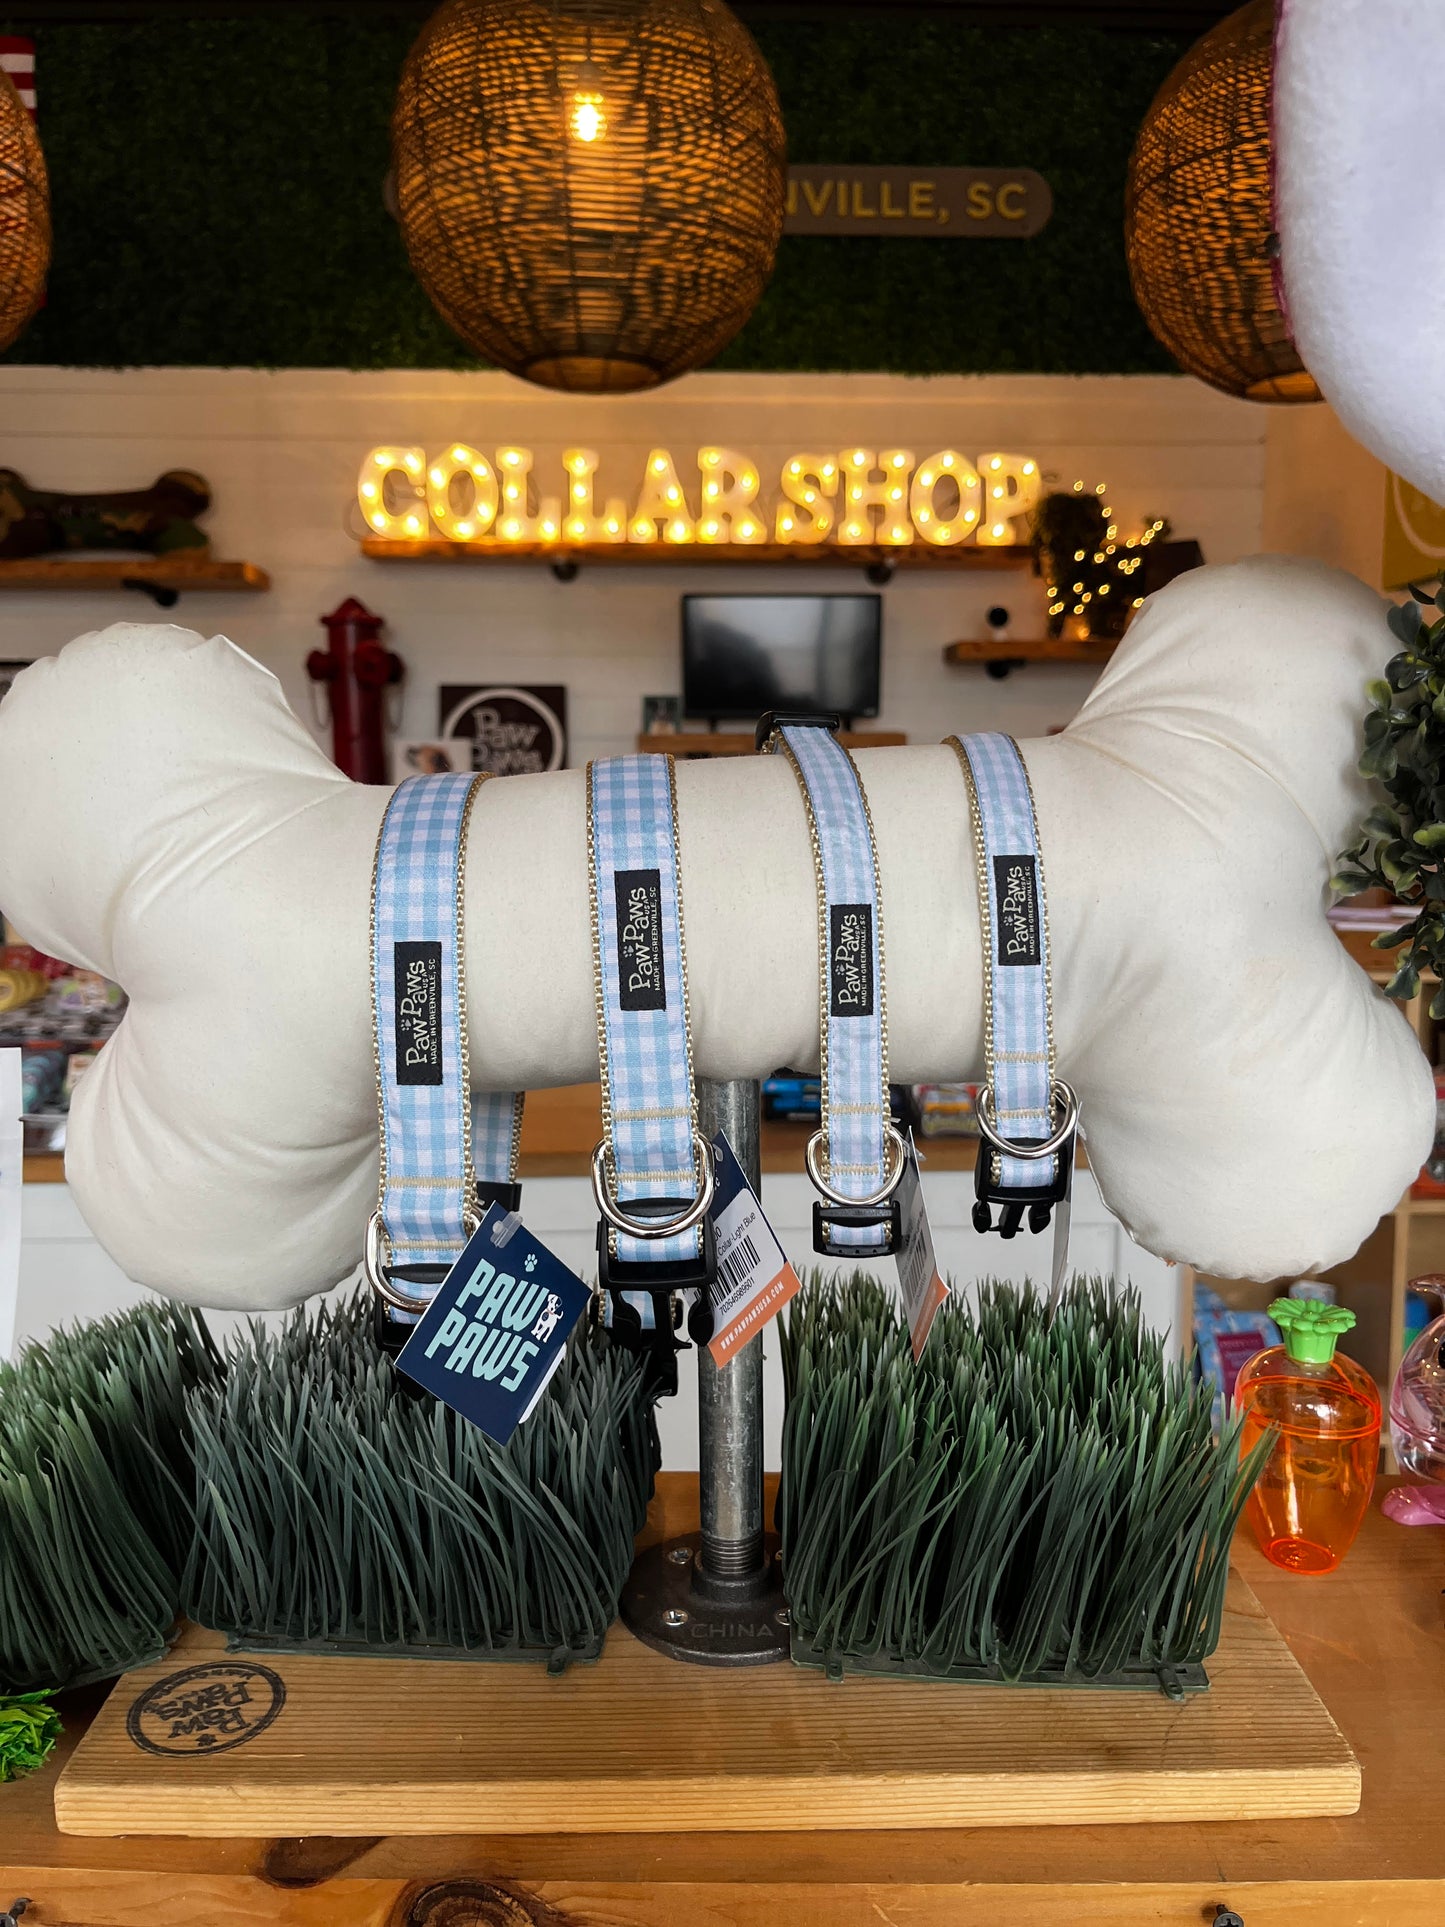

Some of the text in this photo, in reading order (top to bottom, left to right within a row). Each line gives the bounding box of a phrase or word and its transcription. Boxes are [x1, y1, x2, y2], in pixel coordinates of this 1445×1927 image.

[965, 181, 1028, 221] SC
[358, 443, 1041, 546] COLLAR SHOP
[472, 706, 541, 750] Paw
[623, 887, 653, 993] Paw Paws
[649, 886, 661, 991] MADE IN GREENVILLE, SC
[1003, 865, 1029, 956] Paw Paws
[428, 958, 436, 970] SC
[835, 913, 861, 1005] Paw Paws
[400, 960, 430, 1067] Paw Paws
[428, 971, 437, 1027] GREENVILLE,
[430, 1027, 437, 1036] IN
[743, 1211, 756, 1228] Blue
[455, 1257, 550, 1332] PAW
[720, 1280, 785, 1351] WWW.PAWPAWSUSA.COM
[424, 1307, 540, 1393] PAWS
[690, 1623, 776, 1639] CHINA
[157, 1681, 254, 1721] Paws
[168, 1707, 252, 1739] Paw
